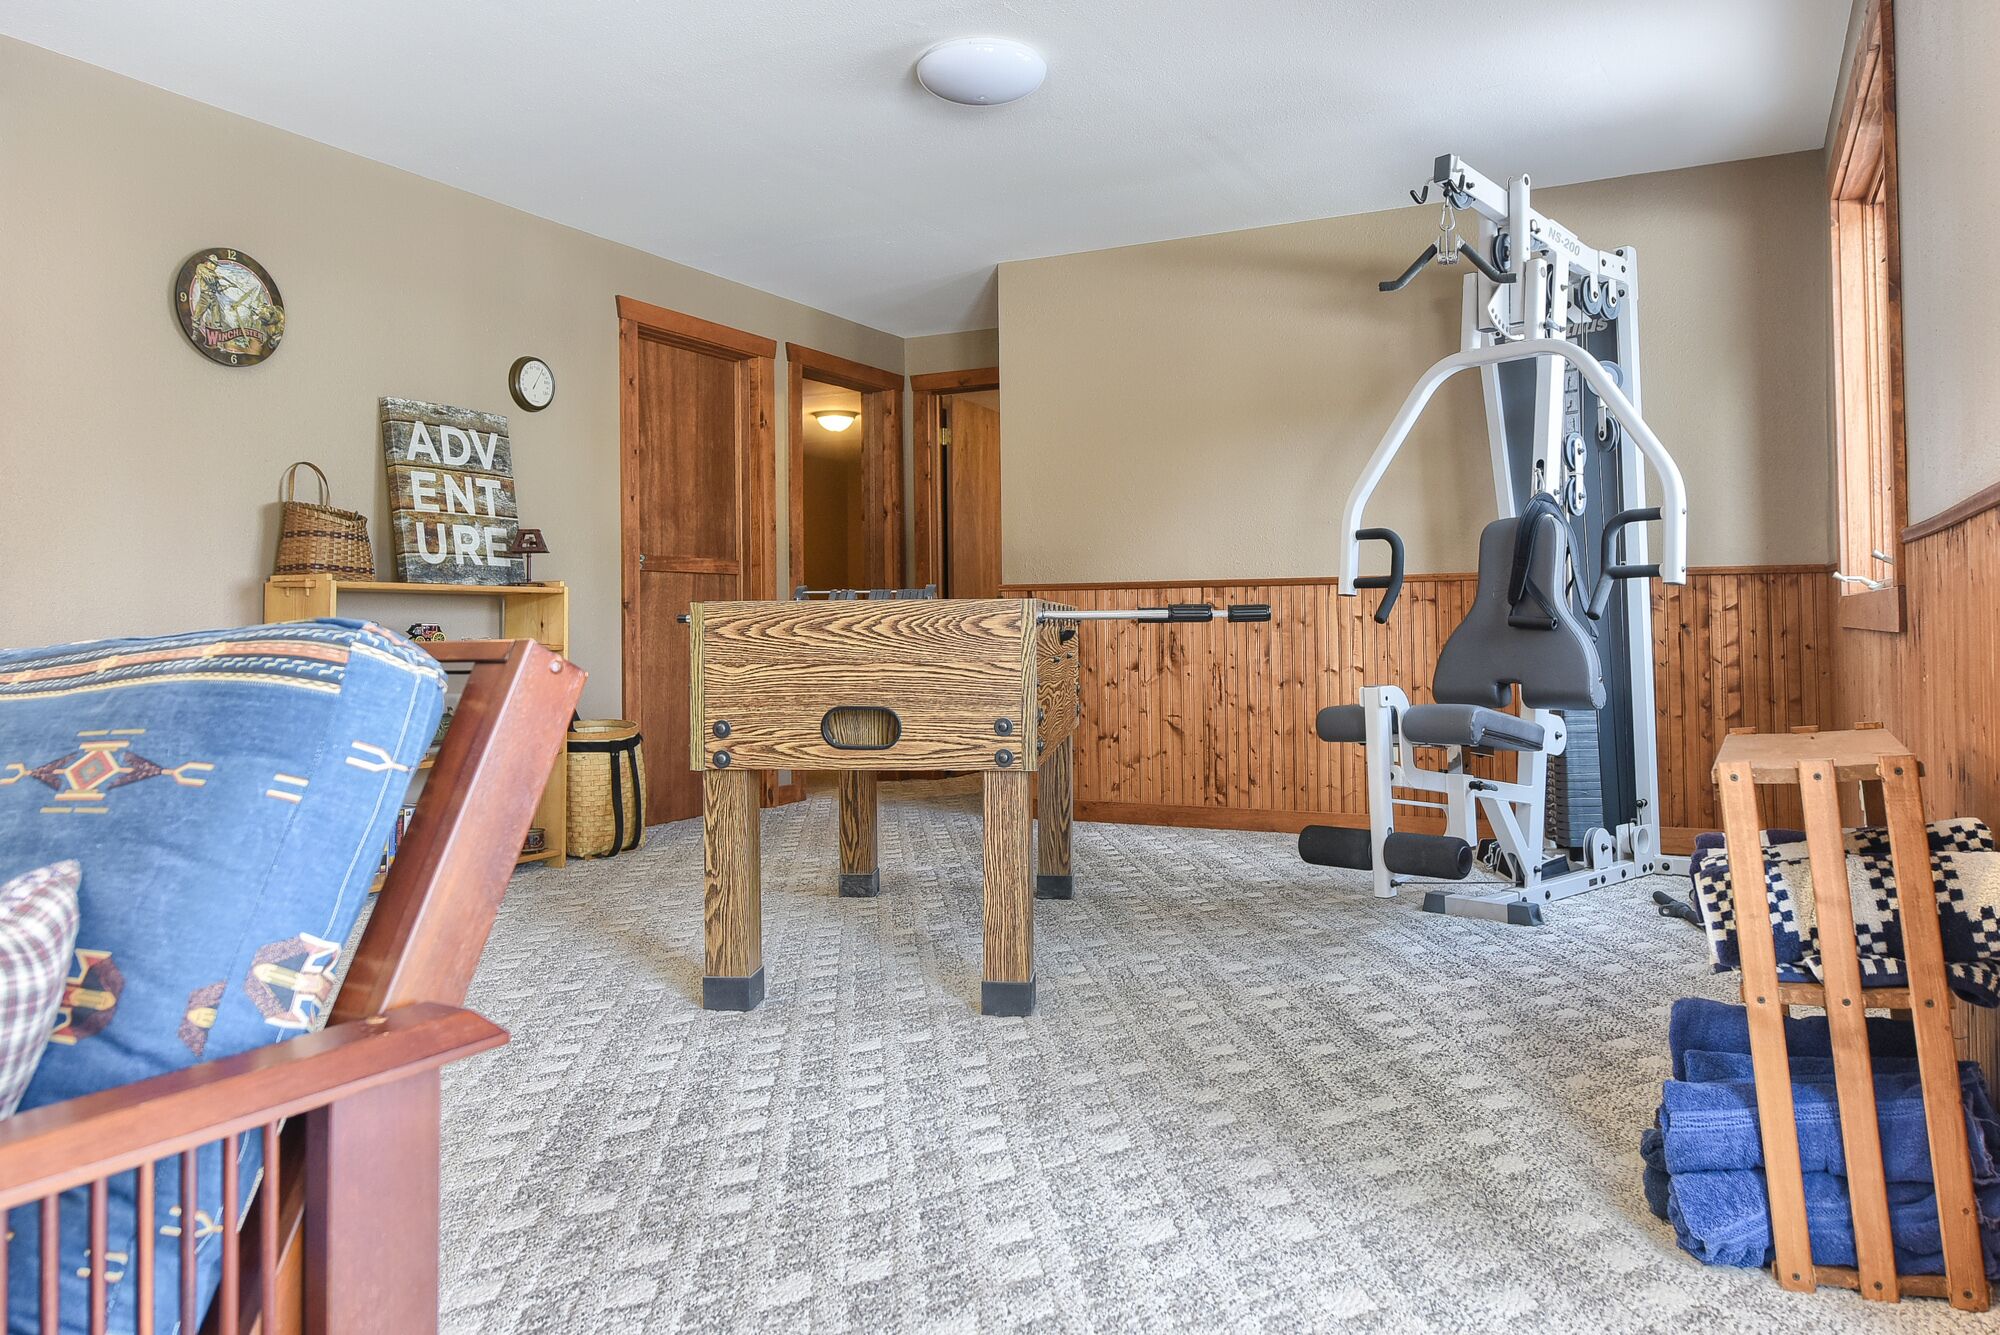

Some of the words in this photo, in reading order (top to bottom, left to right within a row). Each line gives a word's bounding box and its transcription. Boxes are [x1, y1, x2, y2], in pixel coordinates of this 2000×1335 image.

[226, 249, 237, 261] 12
[1548, 226, 1581, 256] NS-200
[179, 292, 188, 303] 9
[230, 354, 239, 365] 6
[406, 420, 499, 471] ADV
[410, 470, 502, 518] ENT
[415, 521, 512, 568] URE
